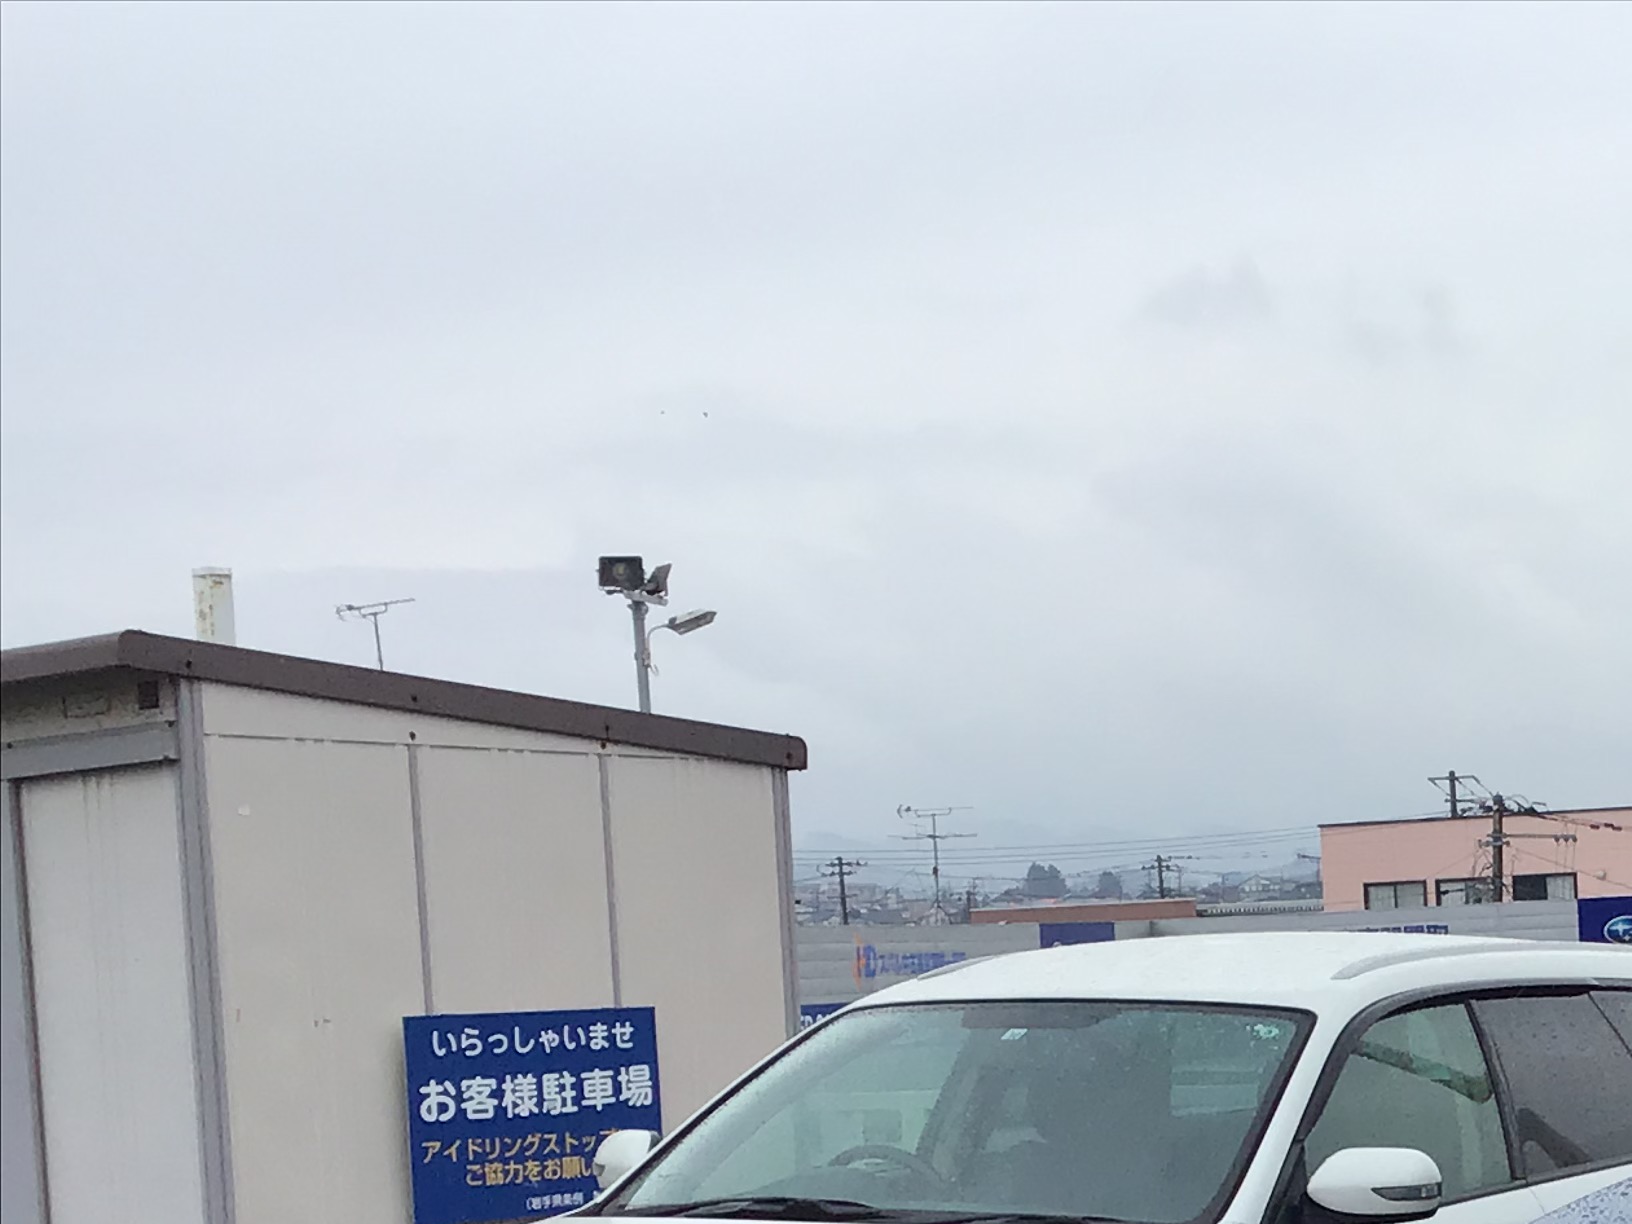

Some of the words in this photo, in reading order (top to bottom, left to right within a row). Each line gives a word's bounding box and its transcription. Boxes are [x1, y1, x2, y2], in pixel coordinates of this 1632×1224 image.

[431, 1021, 634, 1057] いらっしゃいませ
[419, 1063, 653, 1122] お客様駐車場
[421, 1127, 618, 1164] アイドリングストッ
